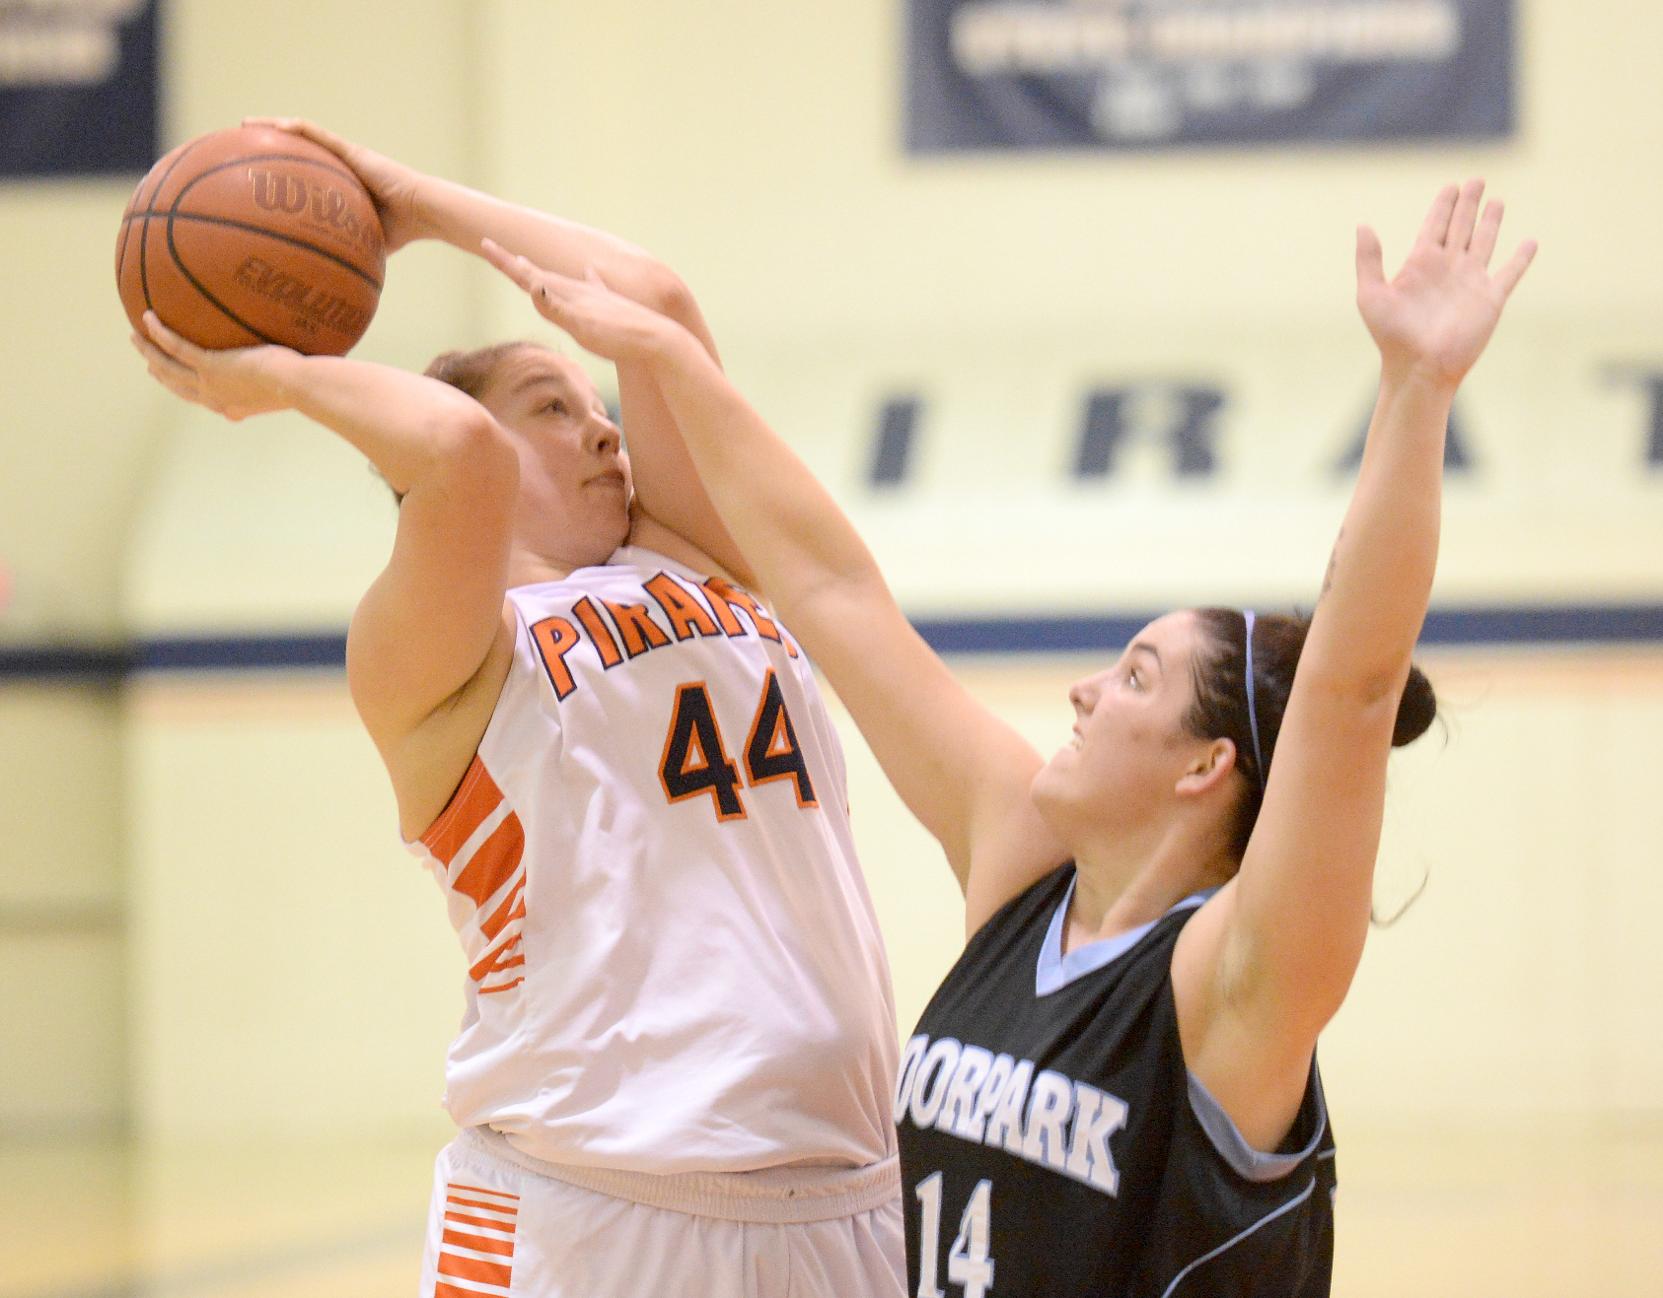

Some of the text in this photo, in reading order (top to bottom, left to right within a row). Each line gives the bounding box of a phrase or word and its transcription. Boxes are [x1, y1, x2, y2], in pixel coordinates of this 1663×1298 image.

[247, 167, 384, 256] Wilso
[529, 569, 799, 703] PIRATE
[657, 665, 820, 823] 44
[892, 1033, 1130, 1199] OORPARK
[914, 1170, 995, 1298] 14
